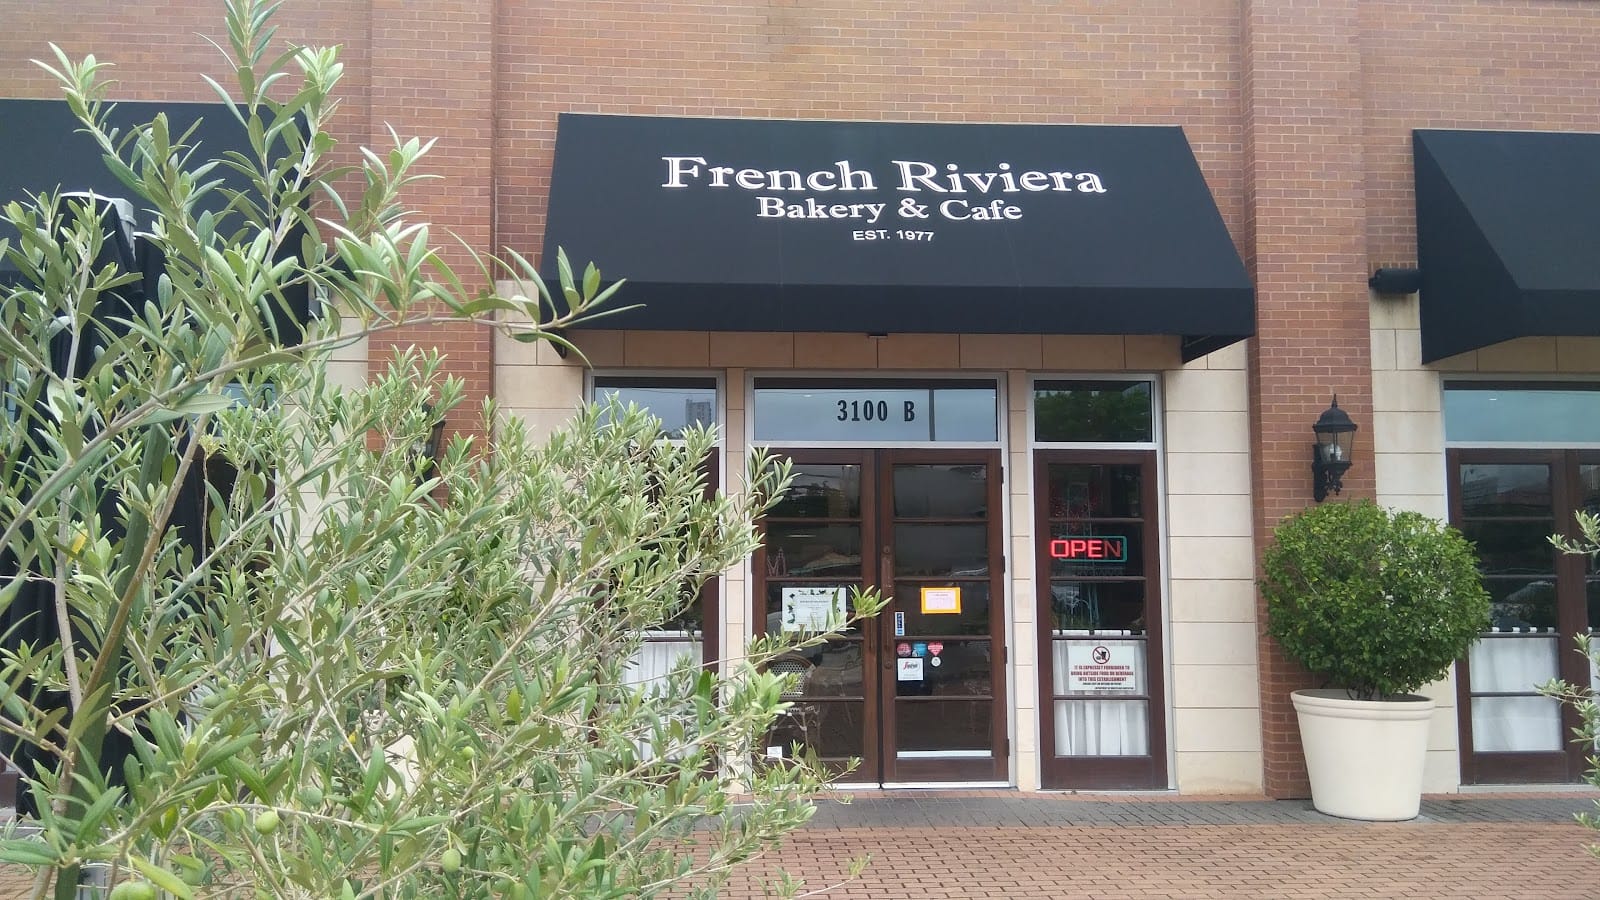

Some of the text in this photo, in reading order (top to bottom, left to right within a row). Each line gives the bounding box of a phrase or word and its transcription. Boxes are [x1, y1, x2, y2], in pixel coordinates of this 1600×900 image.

[661, 156, 1108, 194] French Riviera
[755, 196, 1023, 224] Bakery & Cafe
[852, 229, 935, 242] EST. 1977
[837, 399, 915, 422] 3100 B
[1050, 539, 1122, 558] OPEN
